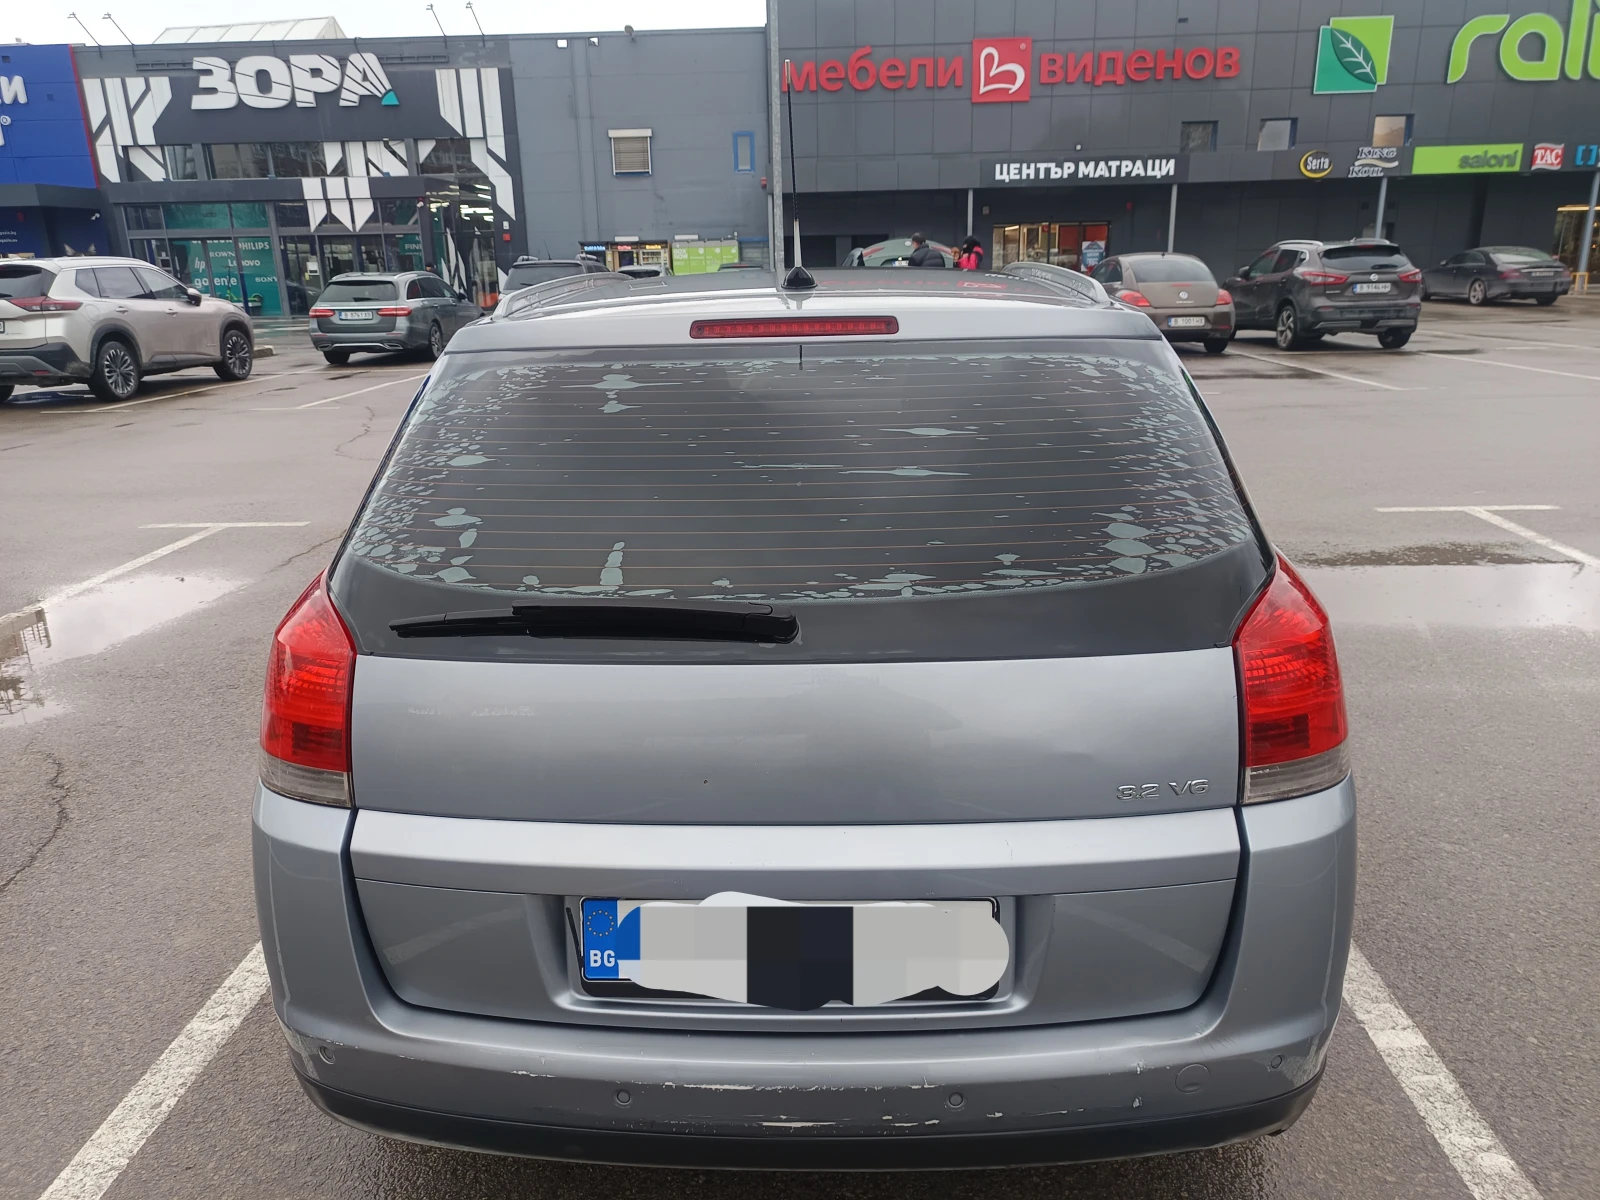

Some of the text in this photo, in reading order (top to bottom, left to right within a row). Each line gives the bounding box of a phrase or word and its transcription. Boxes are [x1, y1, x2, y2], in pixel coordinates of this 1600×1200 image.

[781, 45, 1241, 93] мебели виденов
[0, 75, 28, 104] и
[191, 52, 399, 110] ЗОРА
[1357, 146, 1397, 159] KING
[1459, 149, 1519, 169] saloni
[994, 158, 1176, 182] ЦЕНТЪР МАТРАЦИ
[1306, 156, 1330, 170] Serta
[1347, 166, 1384, 178] KOIL
[194, 256, 206, 273] hp
[1116, 779, 1209, 801] 3.2 V6
[589, 949, 616, 968] BG
